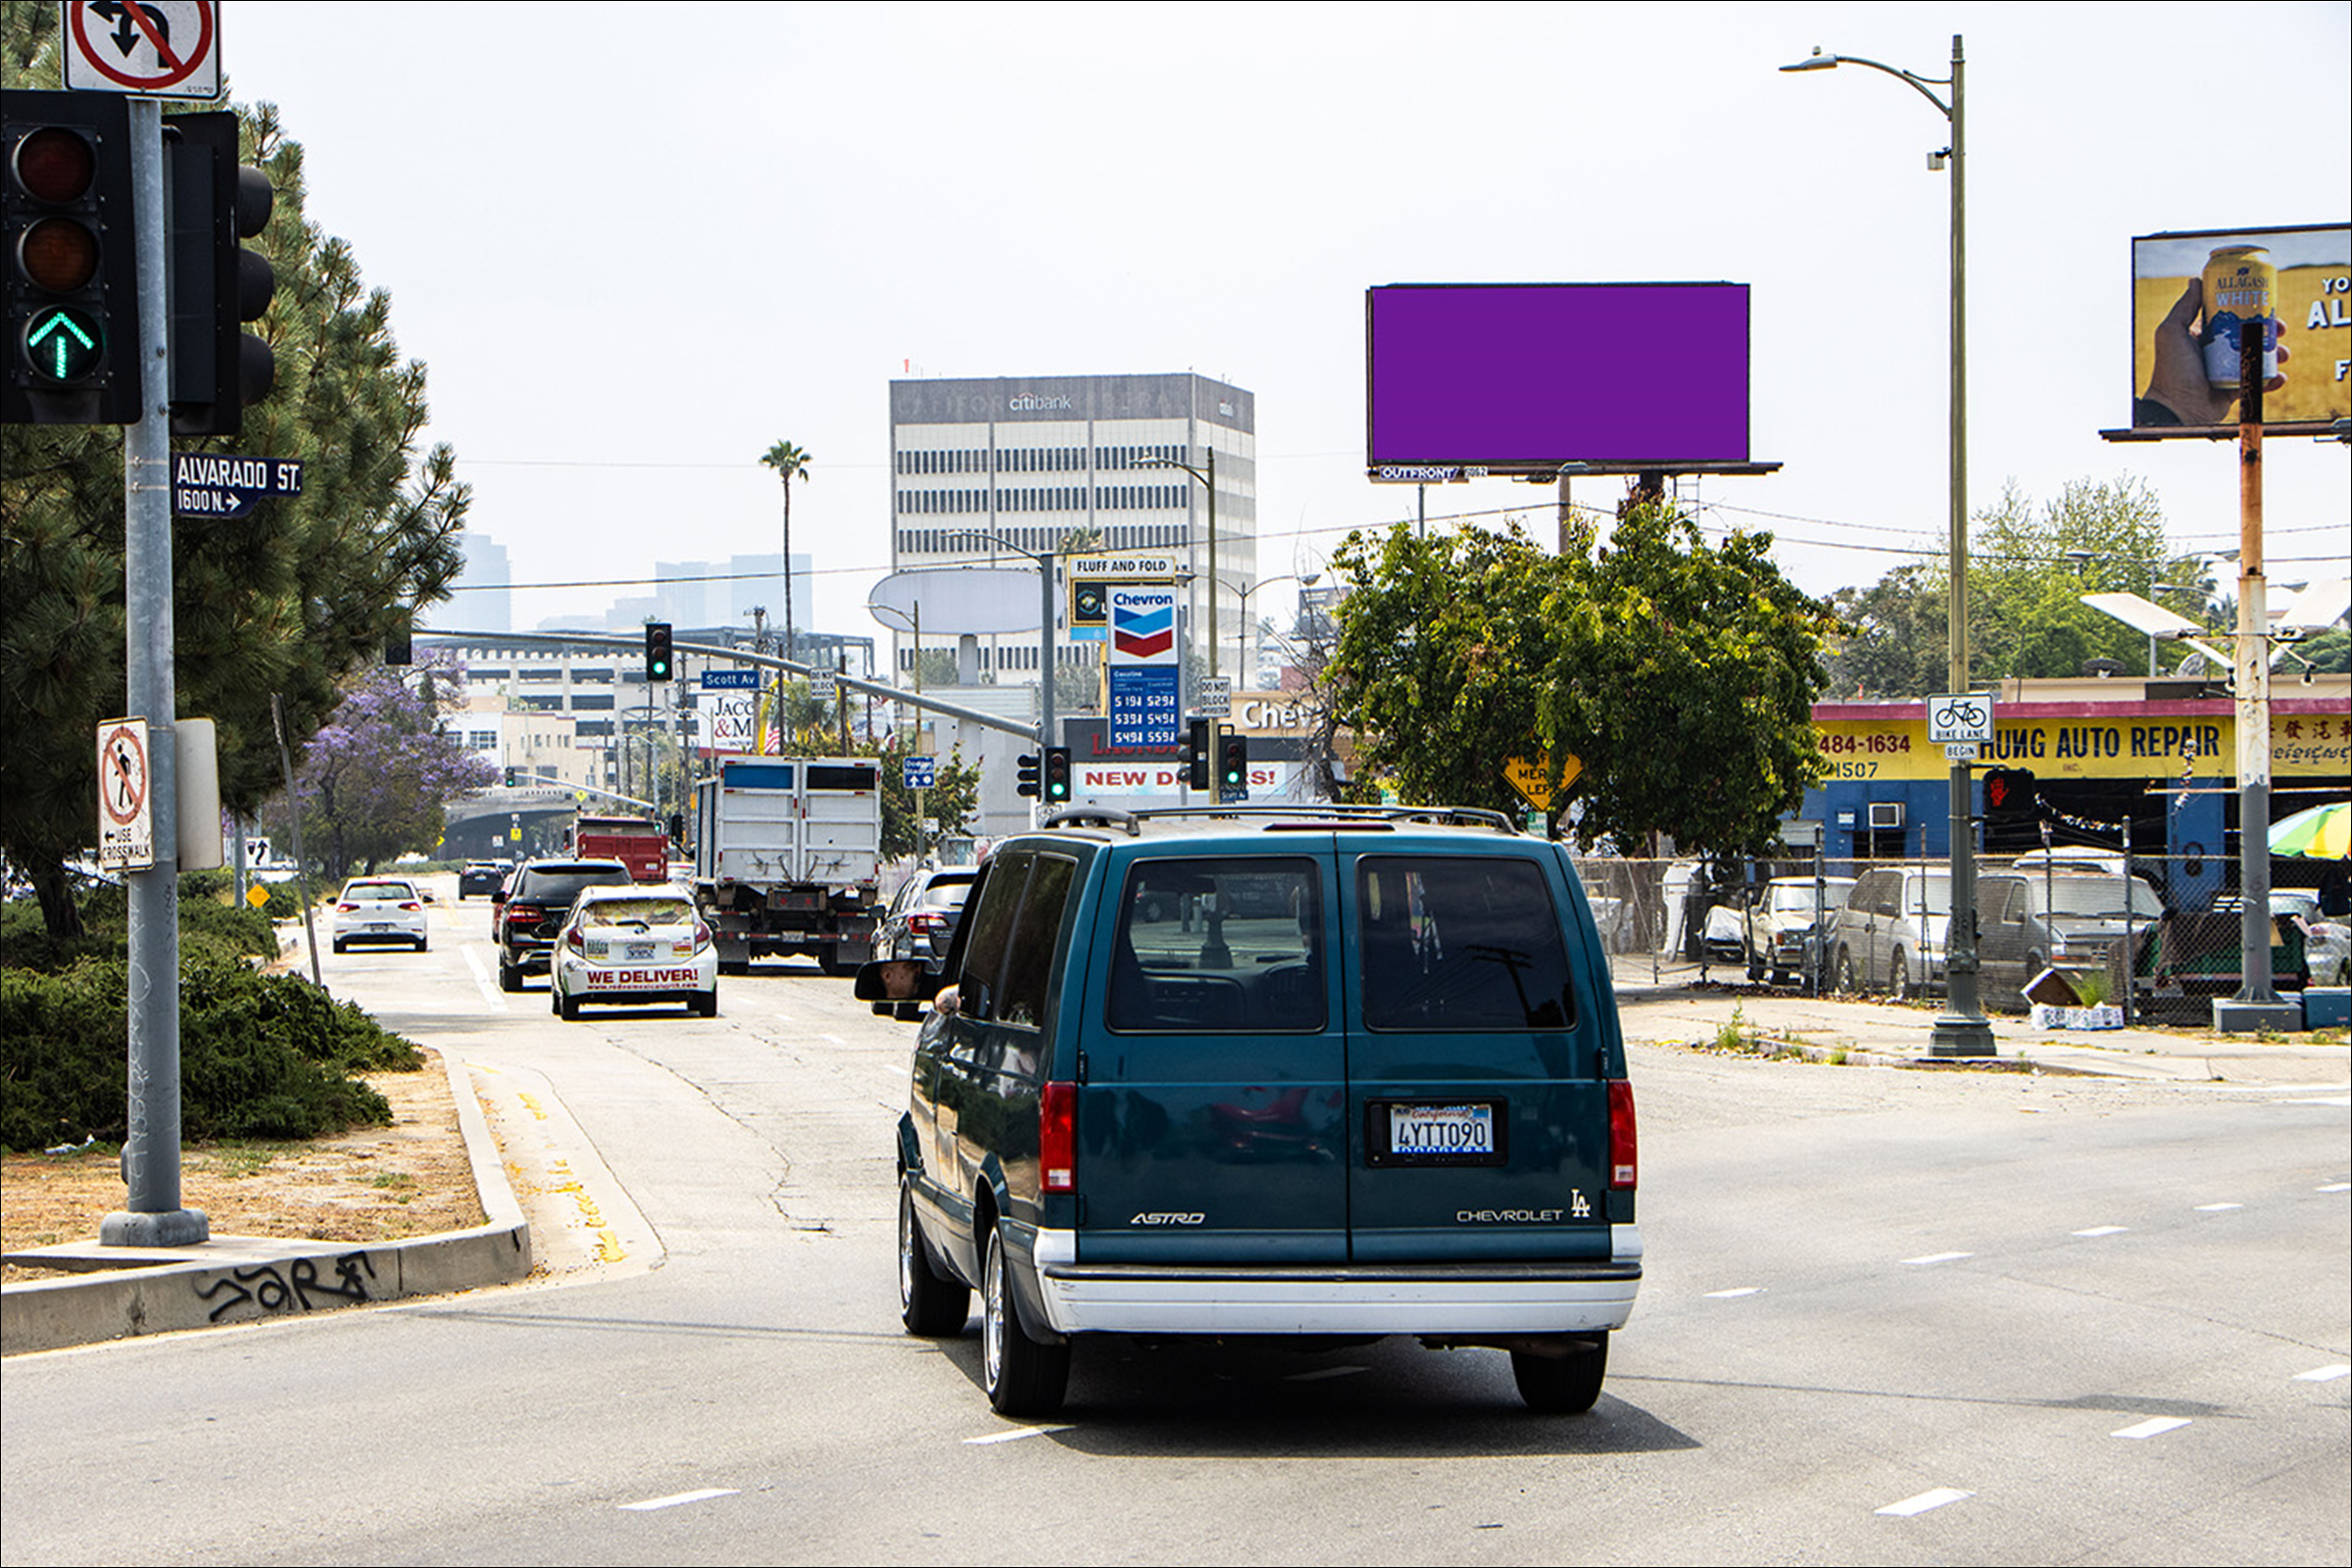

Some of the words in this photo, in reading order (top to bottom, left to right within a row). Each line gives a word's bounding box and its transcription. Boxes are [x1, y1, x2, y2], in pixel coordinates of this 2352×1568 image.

[2215, 290, 2270, 307] WHITE
[1009, 392, 1072, 412] citibank
[176, 456, 268, 489] ALVARADO
[276, 463, 301, 491] ST.
[177, 488, 210, 511] 1600
[212, 490, 225, 512] N.
[1077, 560, 1108, 572] FLUFF
[1111, 561, 1136, 572] AND
[1139, 560, 1167, 572] FOLD
[1113, 592, 1174, 606] Chevron
[707, 673, 737, 686] Scott
[741, 673, 756, 686] Av
[1201, 682, 1212, 693] DO
[1214, 682, 1229, 693] NOT
[1201, 695, 1228, 706] BLOCK
[1936, 729, 1957, 740] BIKE
[1961, 728, 1984, 739] LANE
[2056, 726, 2120, 758] AUTO
[2131, 725, 2220, 757] REPAIR
[1819, 734, 1911, 754] 484-1634
[1947, 745, 1976, 757] BEGIN
[1085, 771, 1148, 786] NEW
[1518, 768, 1547, 780] MER
[1527, 784, 1549, 795] LEF
[116, 828, 132, 843] USE
[102, 843, 152, 860] CROSSWALK
[587, 970, 614, 984] WE
[618, 968, 698, 984] DELIVER!
[1398, 1121, 1487, 1147] 4YTT090
[1571, 1188, 1592, 1218] LA
[1130, 1212, 1205, 1225] ASTRO
[1456, 1209, 1564, 1222] CHEVROLET
